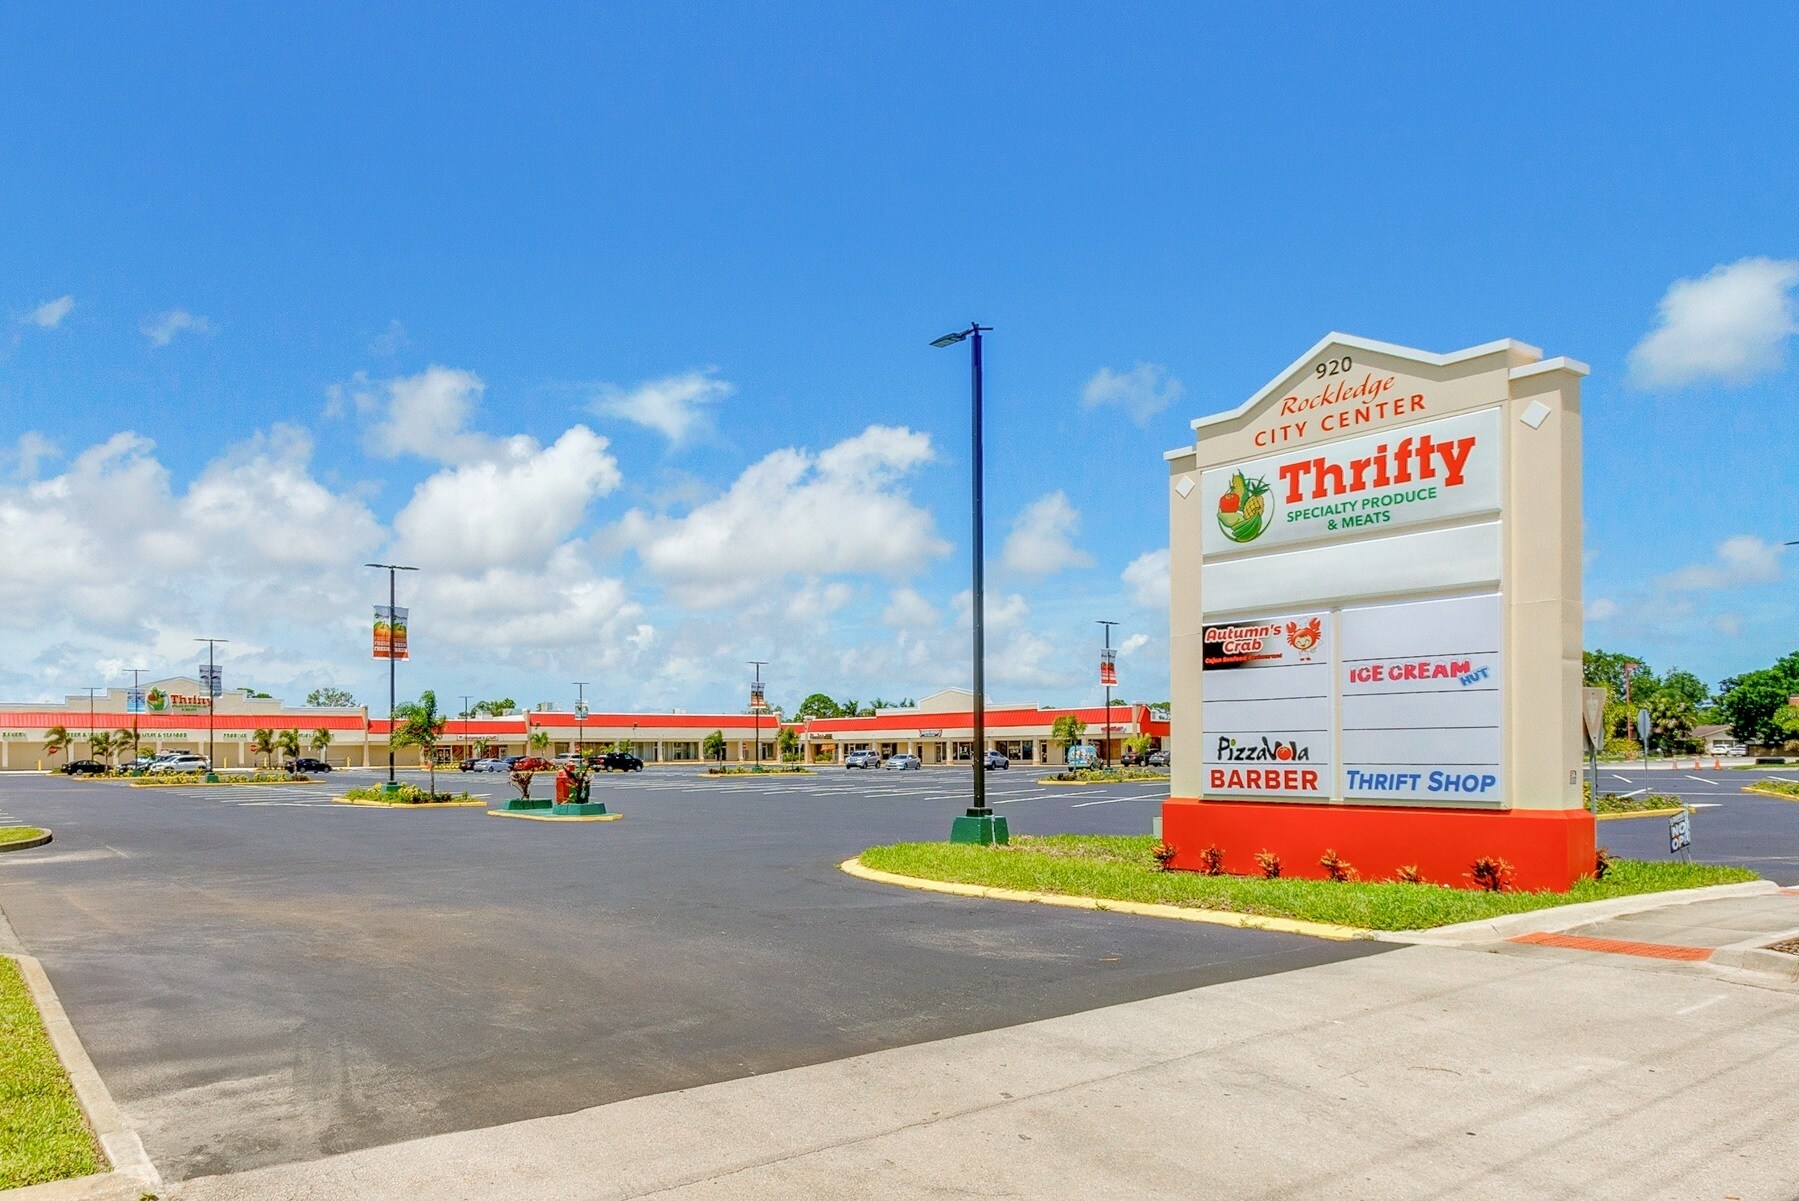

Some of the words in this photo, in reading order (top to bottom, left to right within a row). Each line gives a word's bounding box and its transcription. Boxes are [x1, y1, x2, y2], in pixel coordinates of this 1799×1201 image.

[1315, 356, 1353, 380] 920
[1280, 372, 1396, 417] Rockledge
[1254, 420, 1308, 447] CITY
[1320, 393, 1426, 432] CENTER
[1278, 434, 1476, 505] Thrifty
[1286, 499, 1359, 523] SPECIALTY
[1361, 486, 1438, 511] PRODUCE
[1327, 518, 1338, 531] &
[1341, 510, 1391, 530] MEATS
[1204, 624, 1282, 643] Autumn's
[1222, 639, 1263, 655] Crab
[1349, 664, 1384, 683] ICE
[1387, 659, 1471, 681] CREAM
[1459, 667, 1489, 687] HUT
[1210, 769, 1319, 791] BARBER
[1346, 769, 1421, 791] THRIFT
[1427, 770, 1497, 793] SHOP
